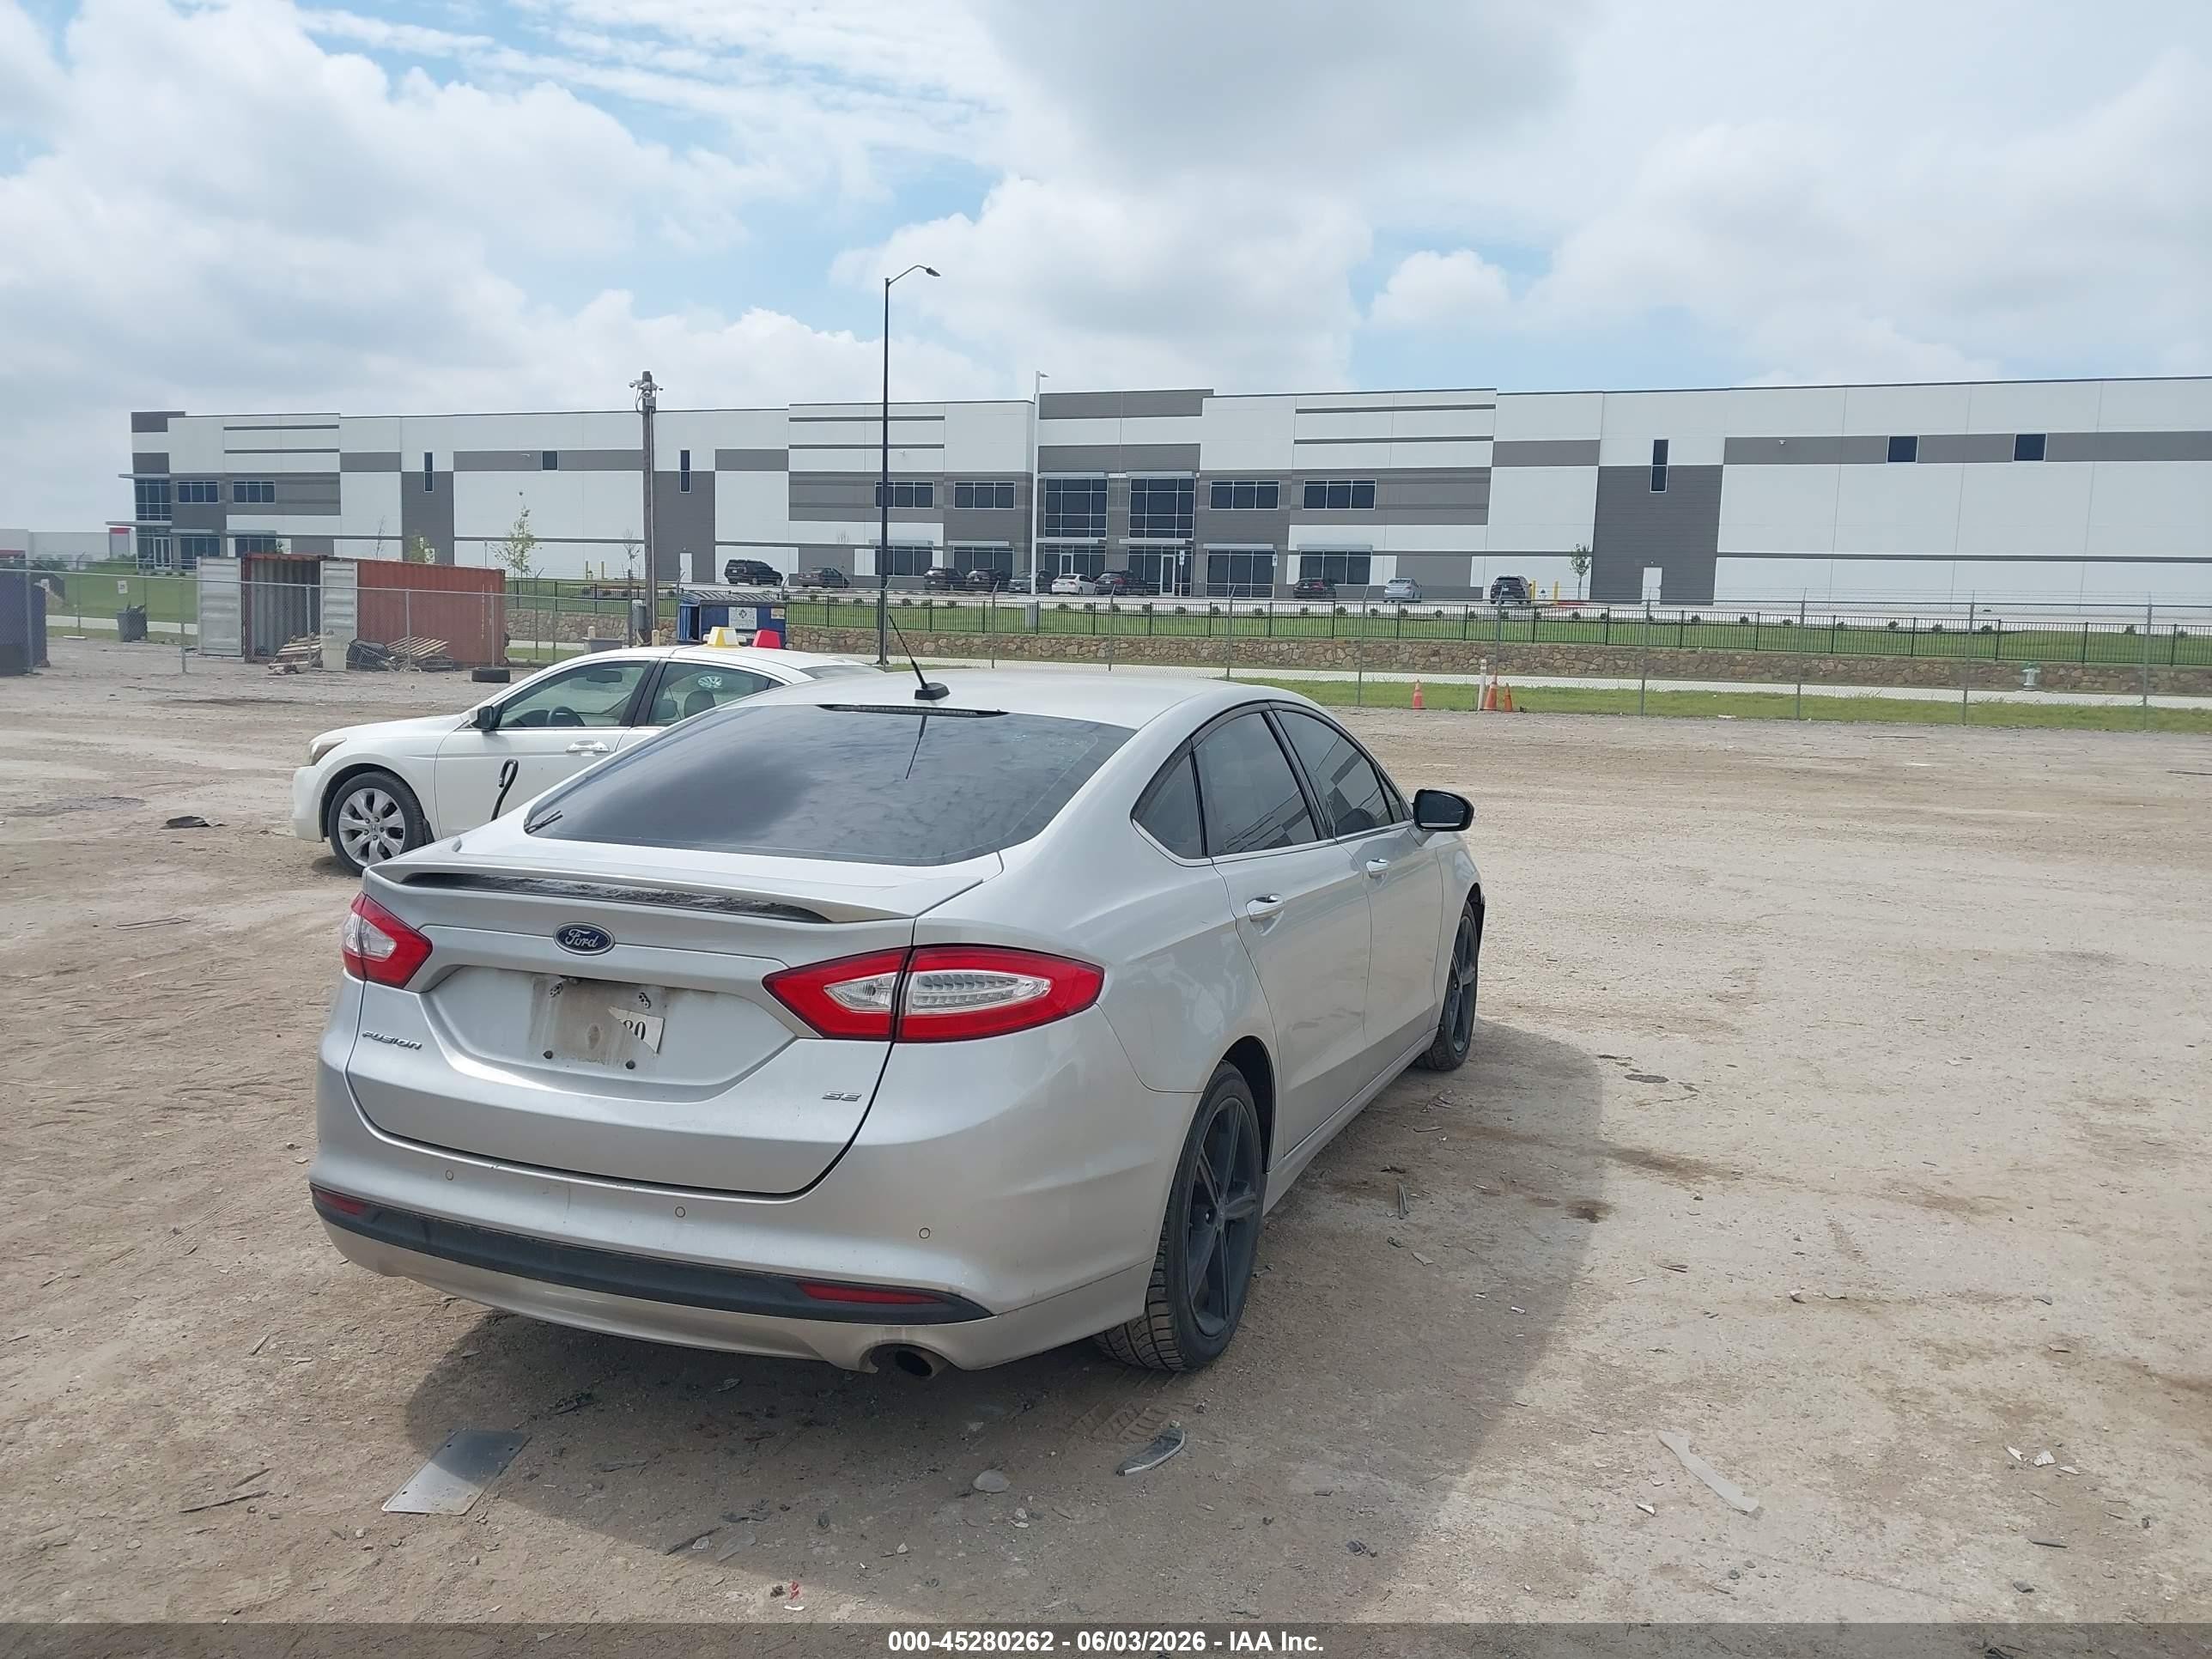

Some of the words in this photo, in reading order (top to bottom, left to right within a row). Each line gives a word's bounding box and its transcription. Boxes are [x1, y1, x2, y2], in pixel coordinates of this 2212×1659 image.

[565, 928, 599, 948] Ford
[362, 1030, 422, 1050] FUSION
[822, 1091, 862, 1102] SE
